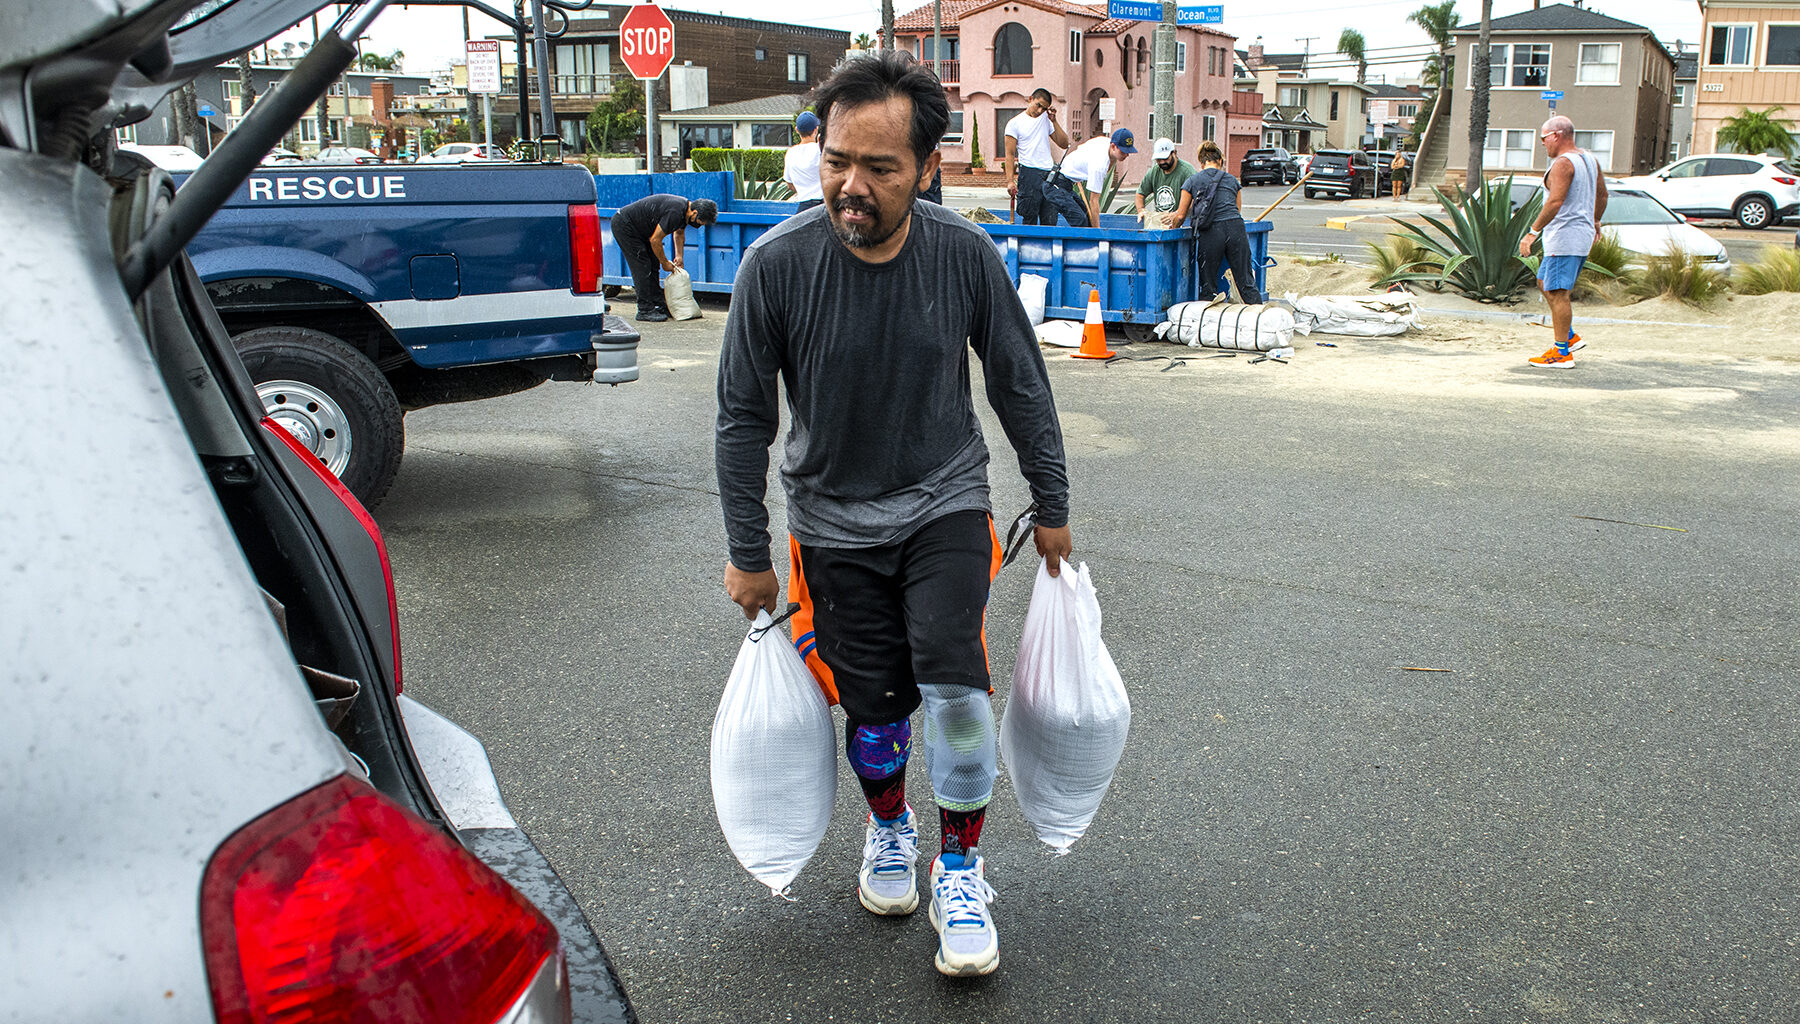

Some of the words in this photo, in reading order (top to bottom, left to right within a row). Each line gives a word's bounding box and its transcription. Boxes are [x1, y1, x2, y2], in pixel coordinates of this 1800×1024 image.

[1111, 3, 1152, 17] Claremont
[1177, 9, 1205, 20] Ocean
[467, 42, 497, 51] WARNING
[624, 27, 671, 56] STOP
[249, 176, 406, 200] RESCUE
